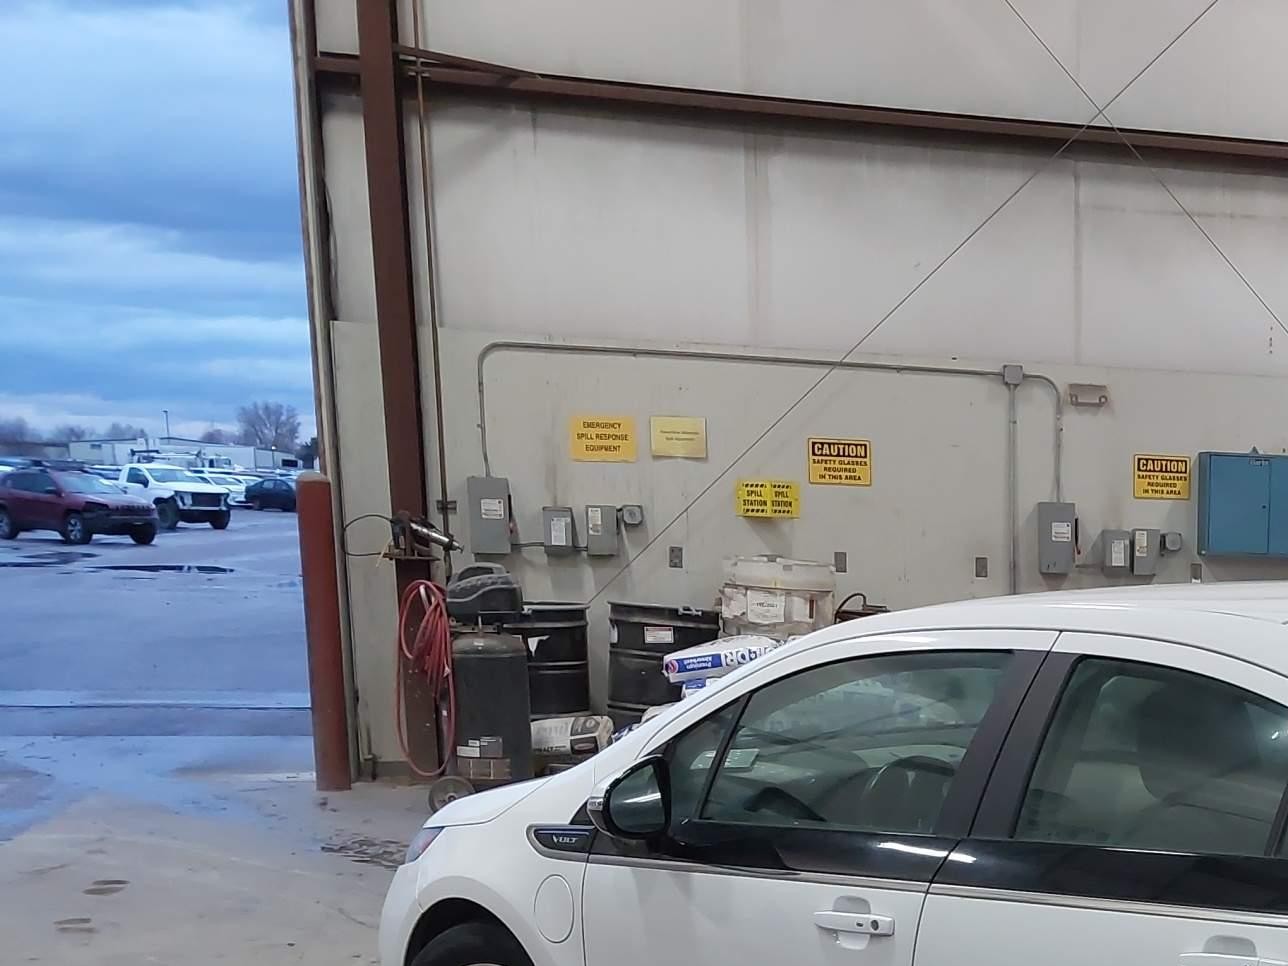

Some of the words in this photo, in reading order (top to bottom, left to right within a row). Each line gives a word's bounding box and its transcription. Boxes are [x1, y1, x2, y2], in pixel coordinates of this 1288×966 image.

[583, 421, 622, 430] EMERGENCY
[595, 433, 629, 441] RESPONSE
[585, 444, 621, 452] EQUIPMENT
[814, 443, 865, 457] CAUTION
[1140, 460, 1186, 472] CAUTION
[552, 835, 580, 844] VOLT
